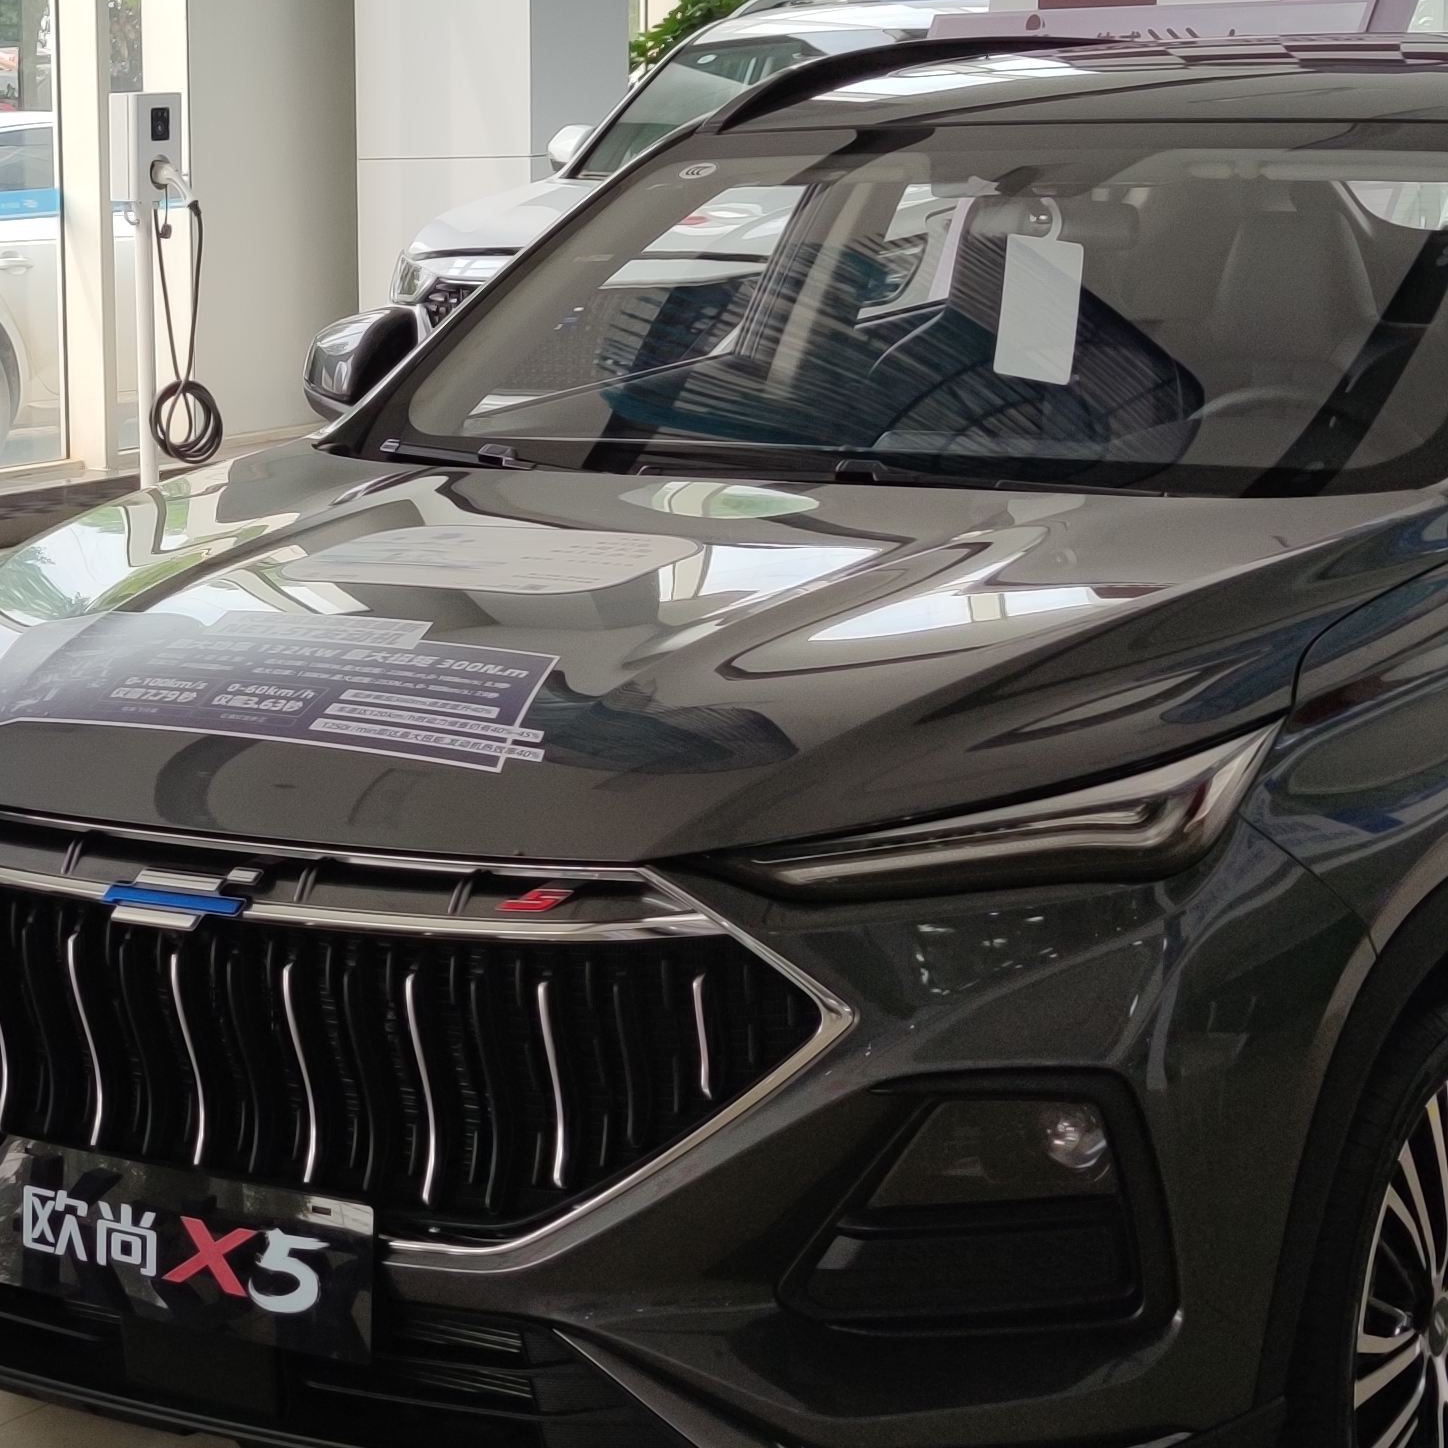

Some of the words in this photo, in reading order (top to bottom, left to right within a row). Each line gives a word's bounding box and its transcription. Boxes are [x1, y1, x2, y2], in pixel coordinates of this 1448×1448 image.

[340, 648, 439, 668] 最大扭矩
[226, 682, 319, 700] 0-60km/h
[21, 1184, 330, 1315] 欧尚X5
